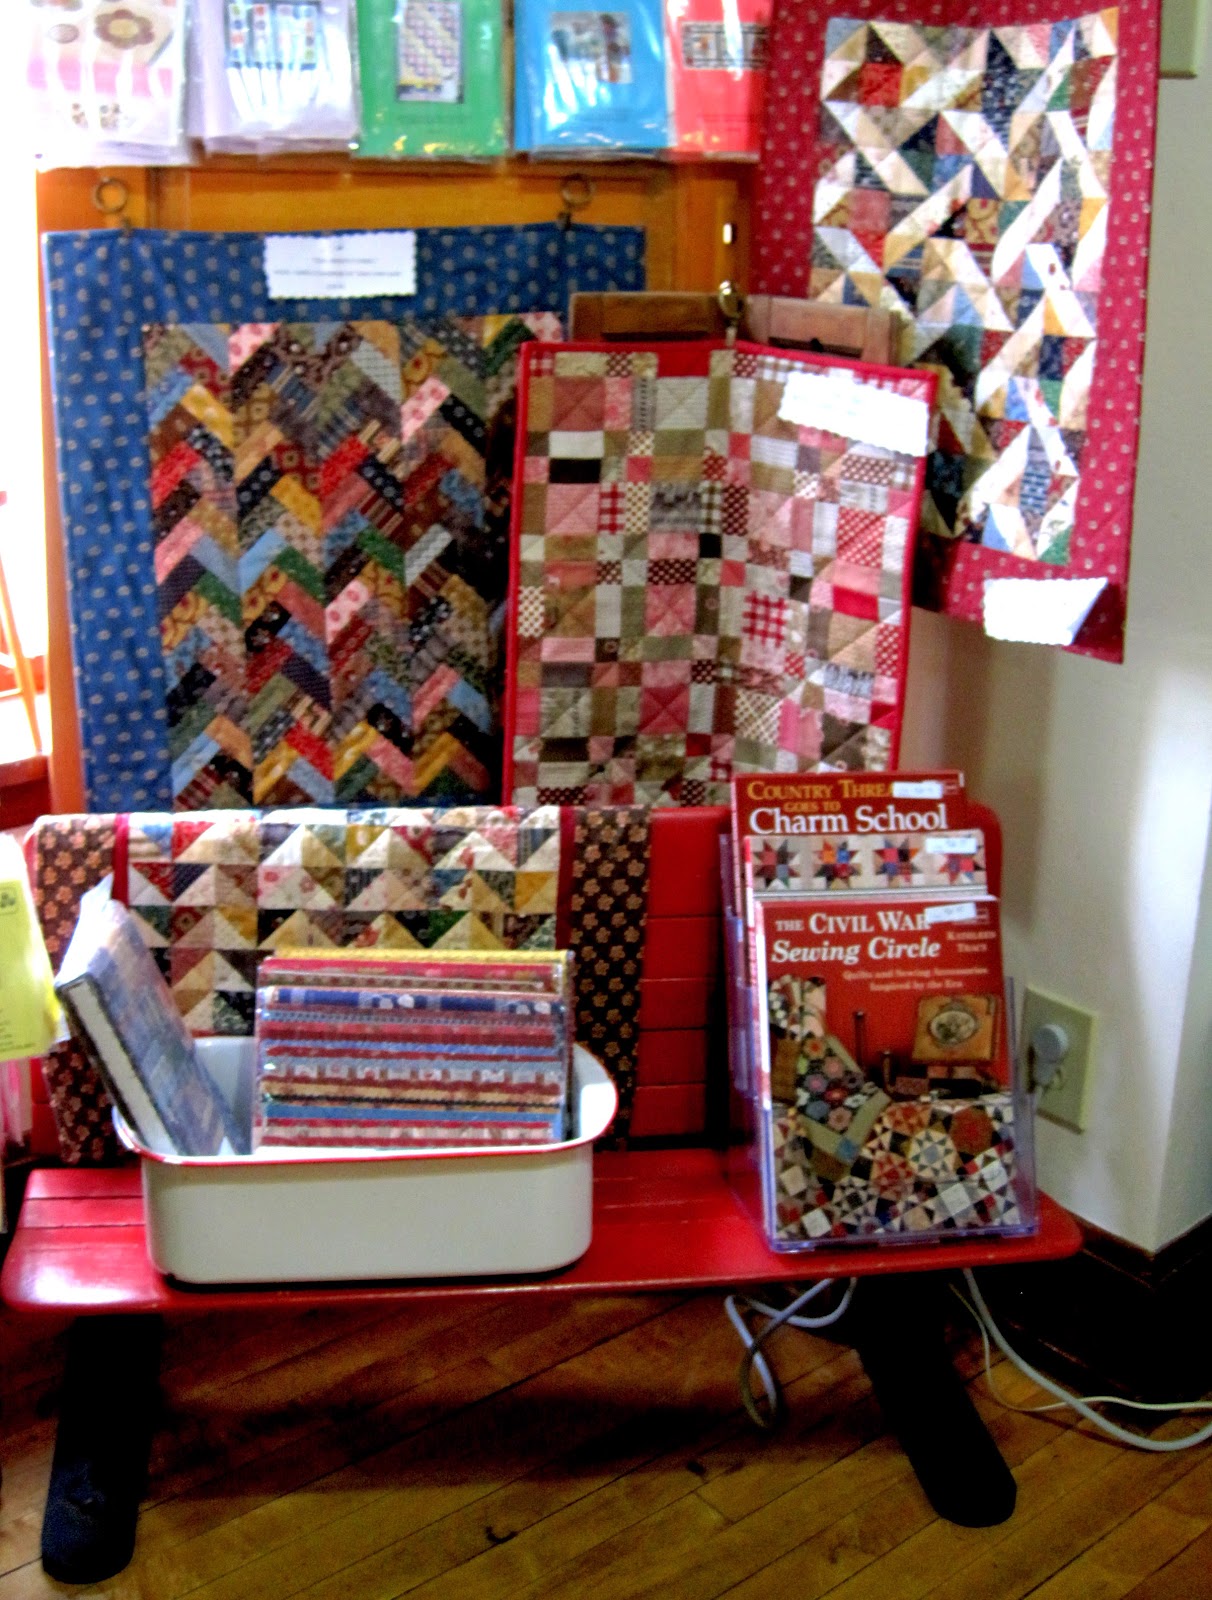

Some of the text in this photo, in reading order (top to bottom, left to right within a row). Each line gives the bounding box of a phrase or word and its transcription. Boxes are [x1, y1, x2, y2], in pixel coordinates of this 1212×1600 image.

[747, 780, 833, 800] COUNTRY
[838, 779, 893, 799] THRE
[824, 801, 841, 812] TO
[750, 803, 948, 834] Charm School
[775, 919, 804, 931] THE
[809, 912, 874, 934] CIVIL
[771, 936, 941, 966] Sewing Circle
